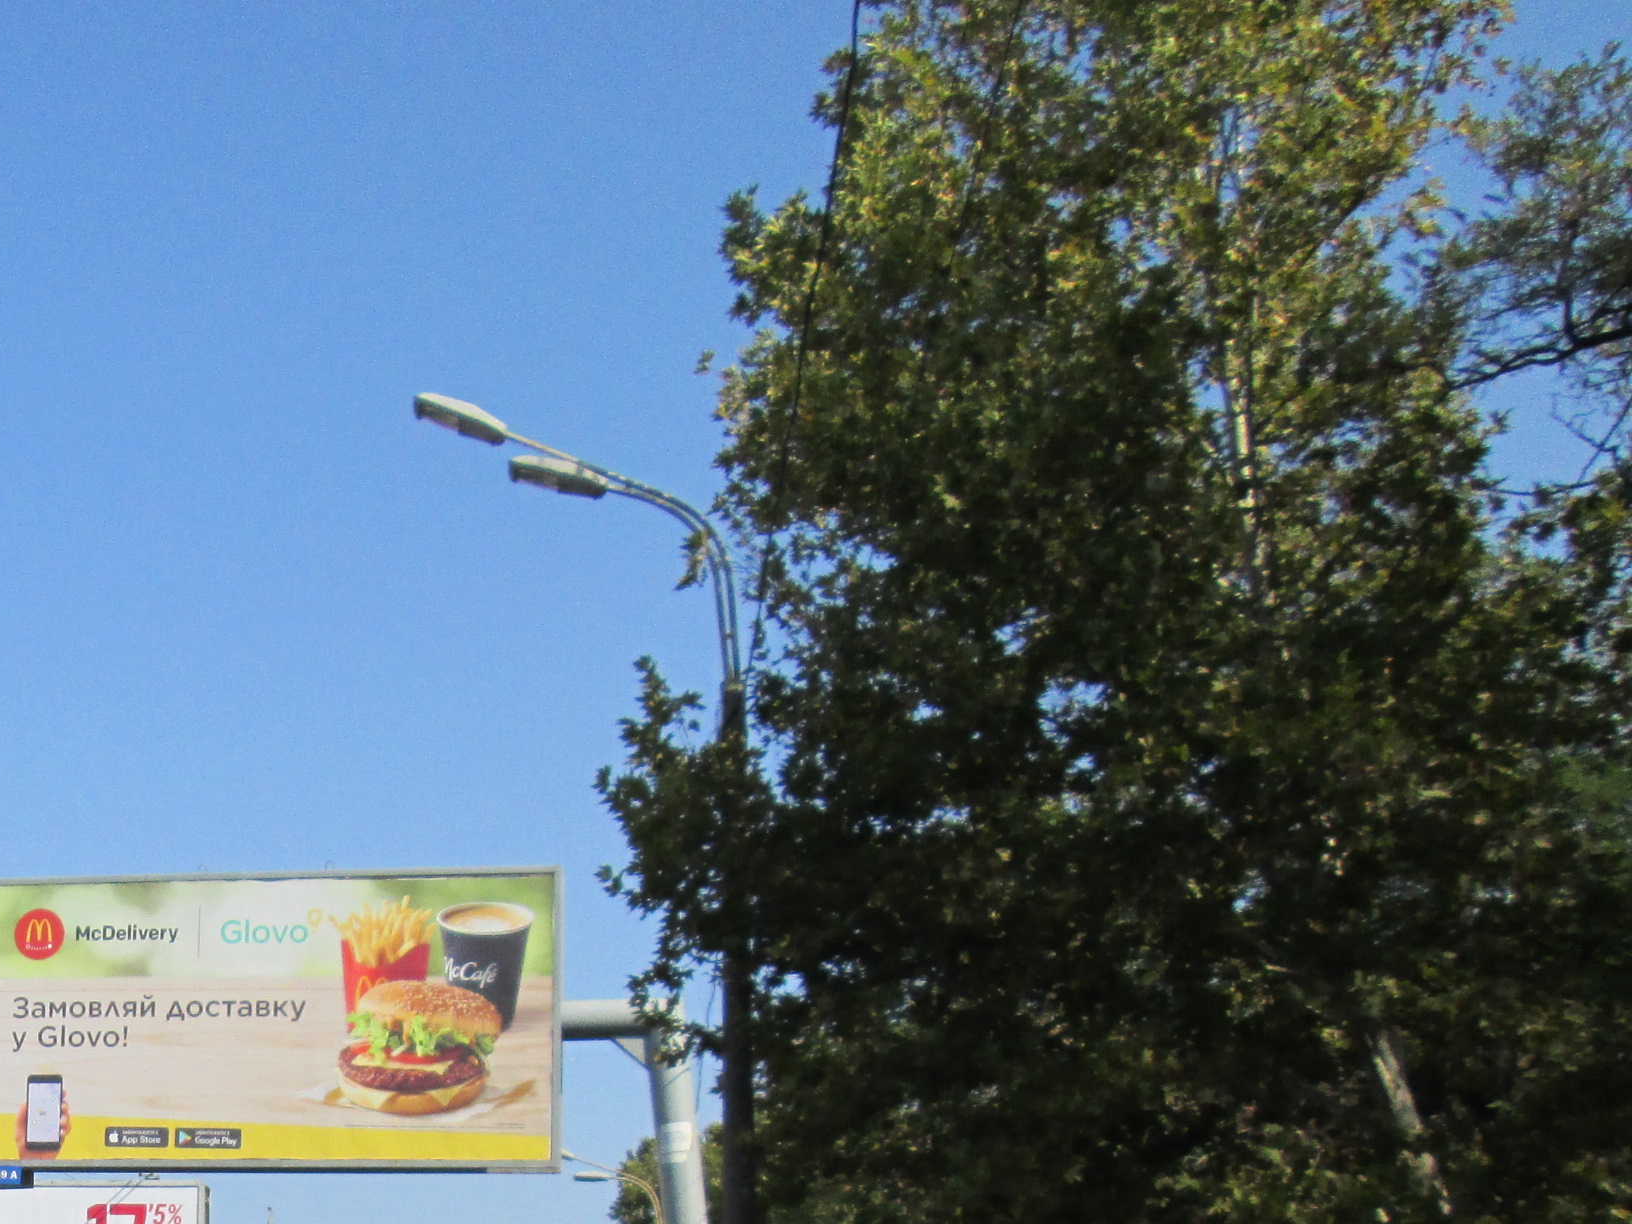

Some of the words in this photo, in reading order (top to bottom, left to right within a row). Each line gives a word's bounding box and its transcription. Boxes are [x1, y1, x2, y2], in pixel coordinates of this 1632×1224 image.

[75, 924, 179, 943] McDelivery
[220, 919, 309, 944] Glovo
[12, 994, 156, 1018] Замовляй
[166, 1000, 306, 1021] доставку
[12, 1031, 27, 1052] у
[38, 1026, 128, 1047] Glovo!
[121, 1136, 137, 1145] App
[140, 1136, 161, 1144] Store
[195, 1136, 220, 1146] Google
[222, 1136, 237, 1146] Play
